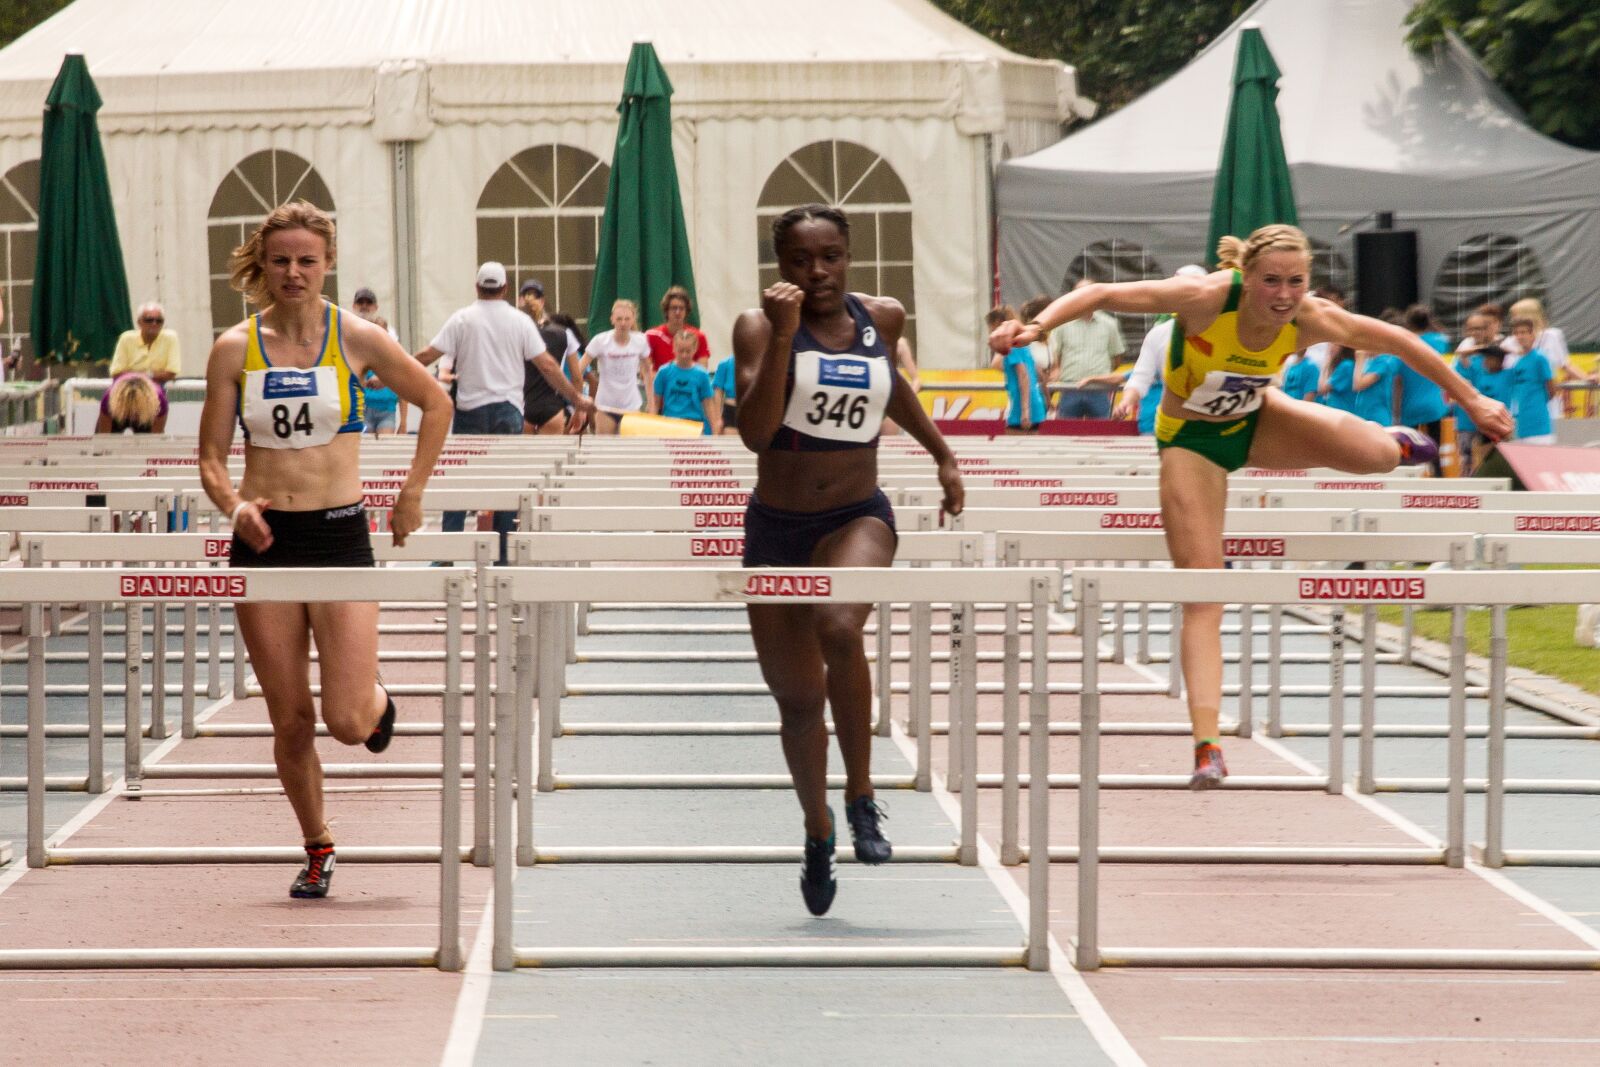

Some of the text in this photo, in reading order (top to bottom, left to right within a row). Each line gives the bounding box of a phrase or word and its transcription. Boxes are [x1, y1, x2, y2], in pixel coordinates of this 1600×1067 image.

[806, 391, 870, 430] 346
[271, 402, 315, 439] 84
[362, 481, 402, 490] AUHA
[681, 494, 750, 506] BAUHAU
[1041, 493, 1117, 505] BAUHAUS
[1402, 496, 1480, 508] BAUHAUS
[325, 505, 358, 520] NIKE
[695, 513, 745, 527] BAUH
[1101, 514, 1164, 528] BAUHA
[1515, 517, 1600, 531] BAUHAUS
[692, 540, 745, 556] BAUH
[1225, 539, 1285, 556] HAUS
[121, 576, 246, 596] BAUHAUS
[1300, 578, 1424, 598] BAUHAUS
